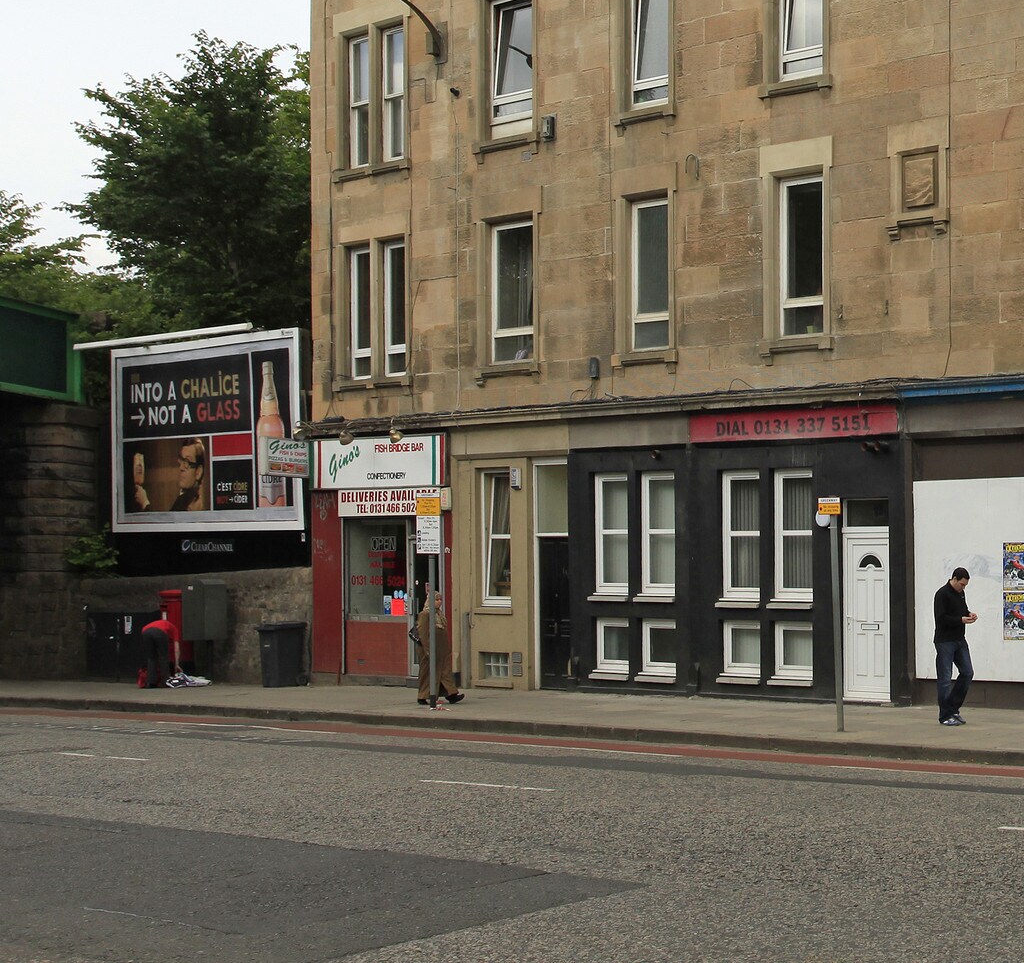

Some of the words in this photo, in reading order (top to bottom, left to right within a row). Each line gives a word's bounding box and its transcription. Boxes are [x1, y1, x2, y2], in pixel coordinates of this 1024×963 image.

[130, 382, 162, 404] INTO
[168, 380, 176, 400] A
[181, 370, 240, 399] CHALICE
[148, 405, 176, 426] NOT
[182, 404, 192, 424] A
[196, 398, 240, 422] GLASS
[716, 420, 748, 436] DIAL
[754, 419, 789, 435] 0131
[796, 417, 826, 432] 337
[832, 415, 870, 432] 5151
[374, 444, 388, 453] FISH
[389, 443, 410, 453] BRIDGE
[411, 442, 424, 452] BAR
[328, 445, 360, 483] Gino's
[367, 472, 406, 480] CONFECTIONERY
[341, 491, 388, 503] DELIVERIES
[356, 504, 368, 514] TEL:
[370, 504, 385, 514] 0131
[386, 503, 400, 513] 466
[372, 538, 396, 550] OPEN
[352, 576, 366, 585] 0131
